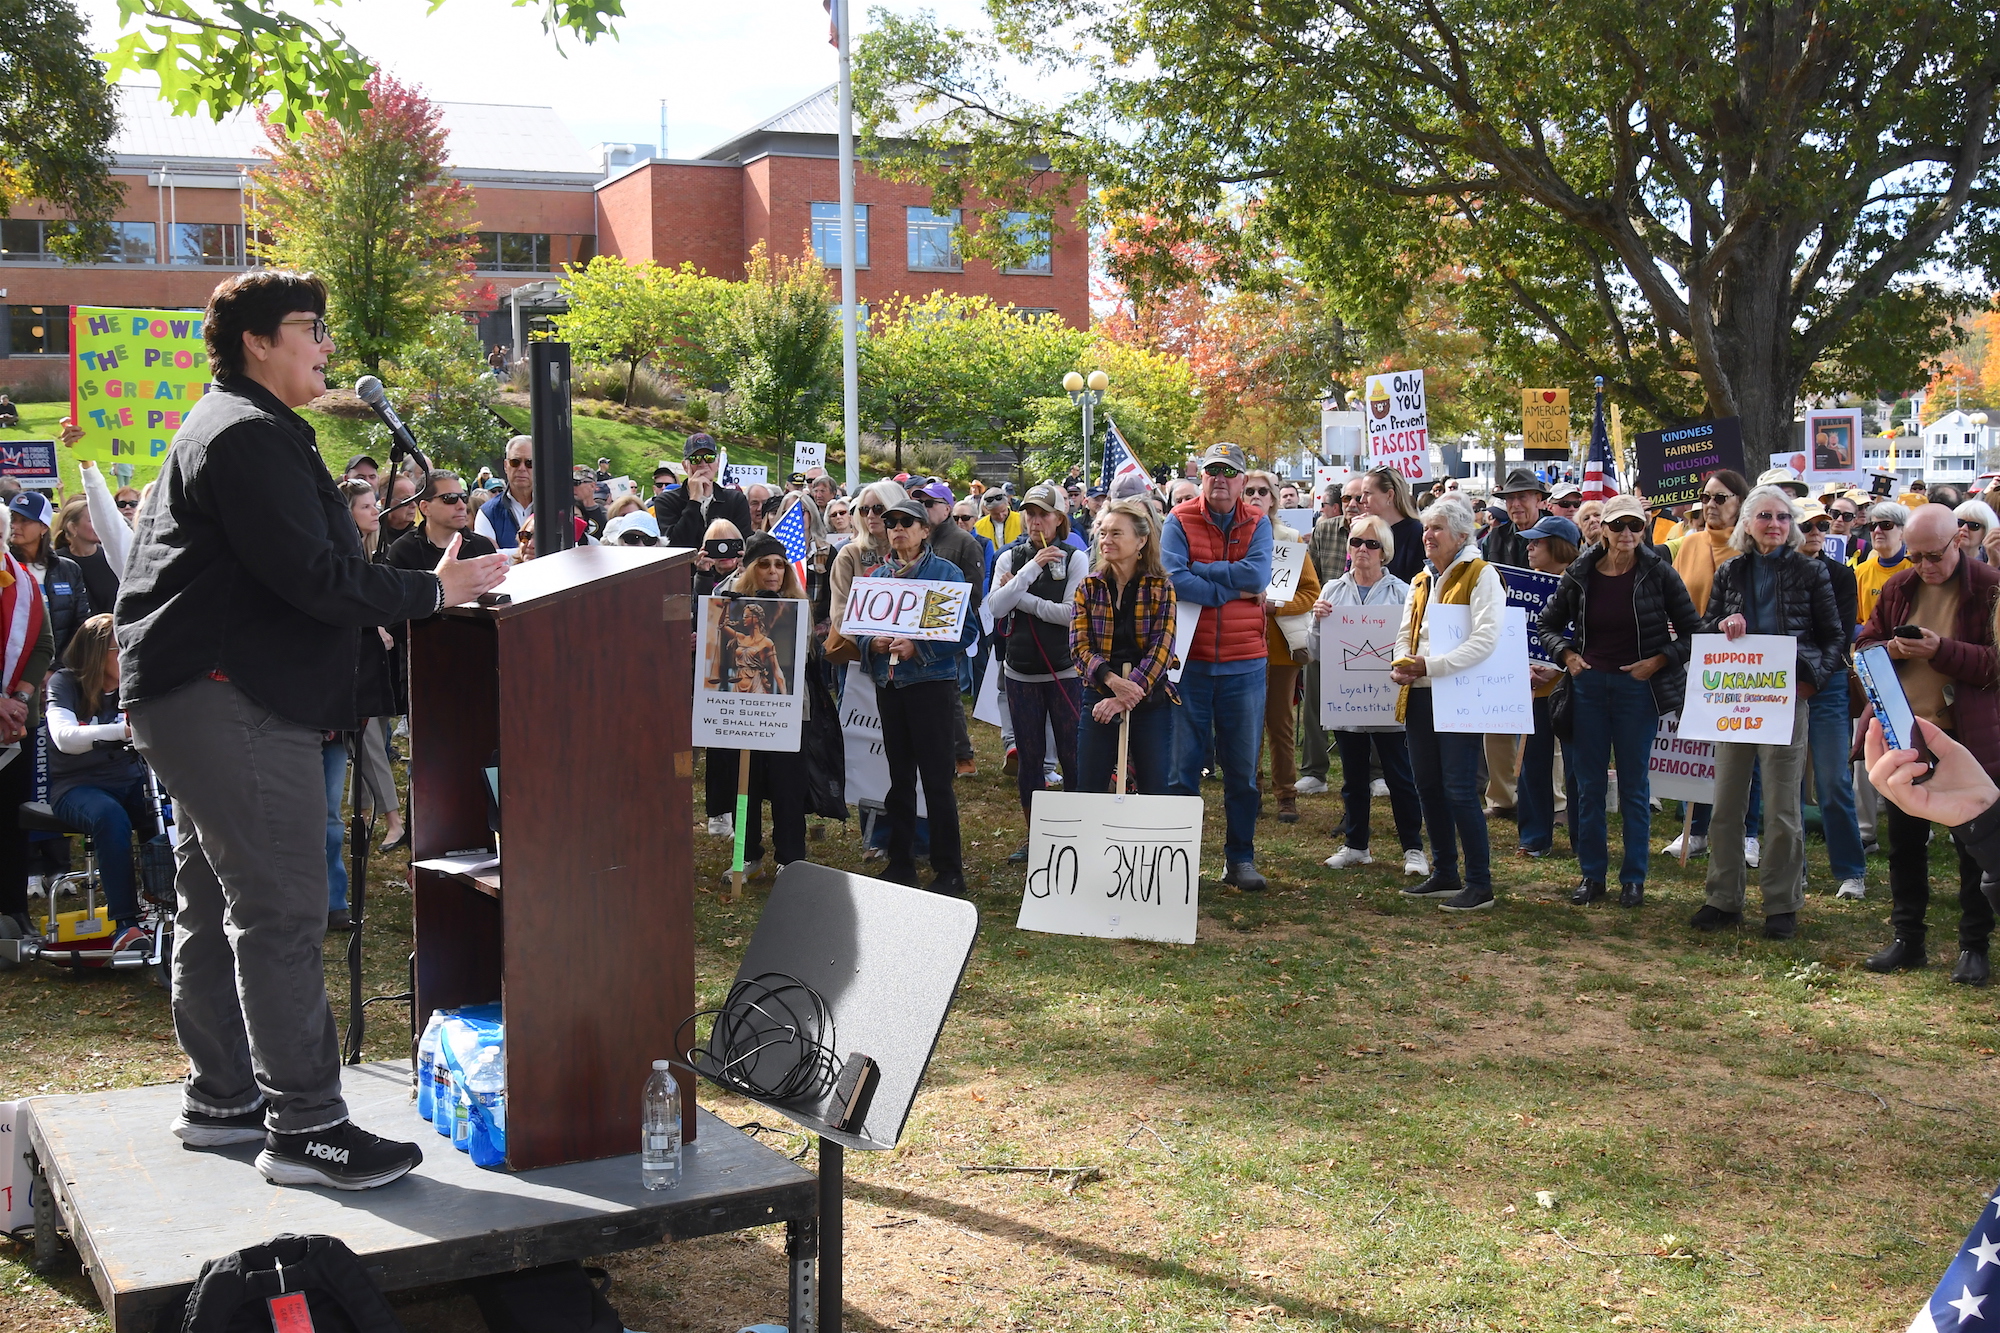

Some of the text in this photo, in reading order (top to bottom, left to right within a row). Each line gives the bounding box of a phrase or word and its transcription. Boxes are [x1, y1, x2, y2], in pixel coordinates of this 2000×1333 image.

[72, 314, 205, 339] THE POWE
[79, 344, 207, 371] THE PEOP
[78, 380, 99, 400] IS
[1394, 374, 1421, 394] Only
[1396, 394, 1421, 411] YOU
[1532, 391, 1538, 403] I
[88, 407, 134, 430] THE
[1524, 405, 1567, 417] AMERICA
[1369, 413, 1425, 433] Can Prevent
[1536, 420, 1554, 430] NO
[1527, 429, 1568, 443] KINGS!
[1661, 424, 1714, 443] KINDNESS
[112, 438, 135, 456] IN
[1372, 428, 1427, 456] FASCIST
[1664, 440, 1714, 457] FAIRNESS
[801, 446, 815, 455] NO
[728, 466, 765, 475] RESIST
[1379, 454, 1423, 478] ARS
[1663, 455, 1719, 472] INCLUSION
[1658, 475, 1687, 489] HOPE
[1689, 473, 1699, 484] &
[1648, 491, 1678, 504] MAKE
[1680, 488, 1695, 500] US
[1506, 585, 1544, 606] haos,
[844, 587, 918, 626] NOP
[1342, 614, 1386, 628] No Kings
[1448, 625, 1463, 640] NO
[1703, 652, 1764, 666] SUPPORT
[1455, 674, 1515, 686] NO TRUMP
[1703, 670, 1787, 690] UKRAINE
[1340, 683, 1391, 699] Loyalty to
[1703, 693, 1788, 705] THEIR DEMOCRACY
[706, 697, 792, 708] HANG TOGETHER
[1327, 702, 1342, 712] The
[1456, 704, 1525, 716] NO VANCE
[1733, 705, 1751, 713] AND
[739, 709, 777, 717] SURELY
[842, 708, 882, 730] fau
[722, 718, 755, 727] SHALL
[759, 720, 788, 729] HANG
[1717, 716, 1763, 732] OURS
[715, 728, 776, 738] SEPARATELY
[36, 725, 47, 784] WOMEN'S
[1654, 737, 1669, 751] TO
[1671, 738, 1711, 757] FIGHT
[1650, 756, 1715, 779] DEMOCRA
[1028, 843, 1190, 905] WAKE UP
[304, 1140, 350, 1165] HOKA
